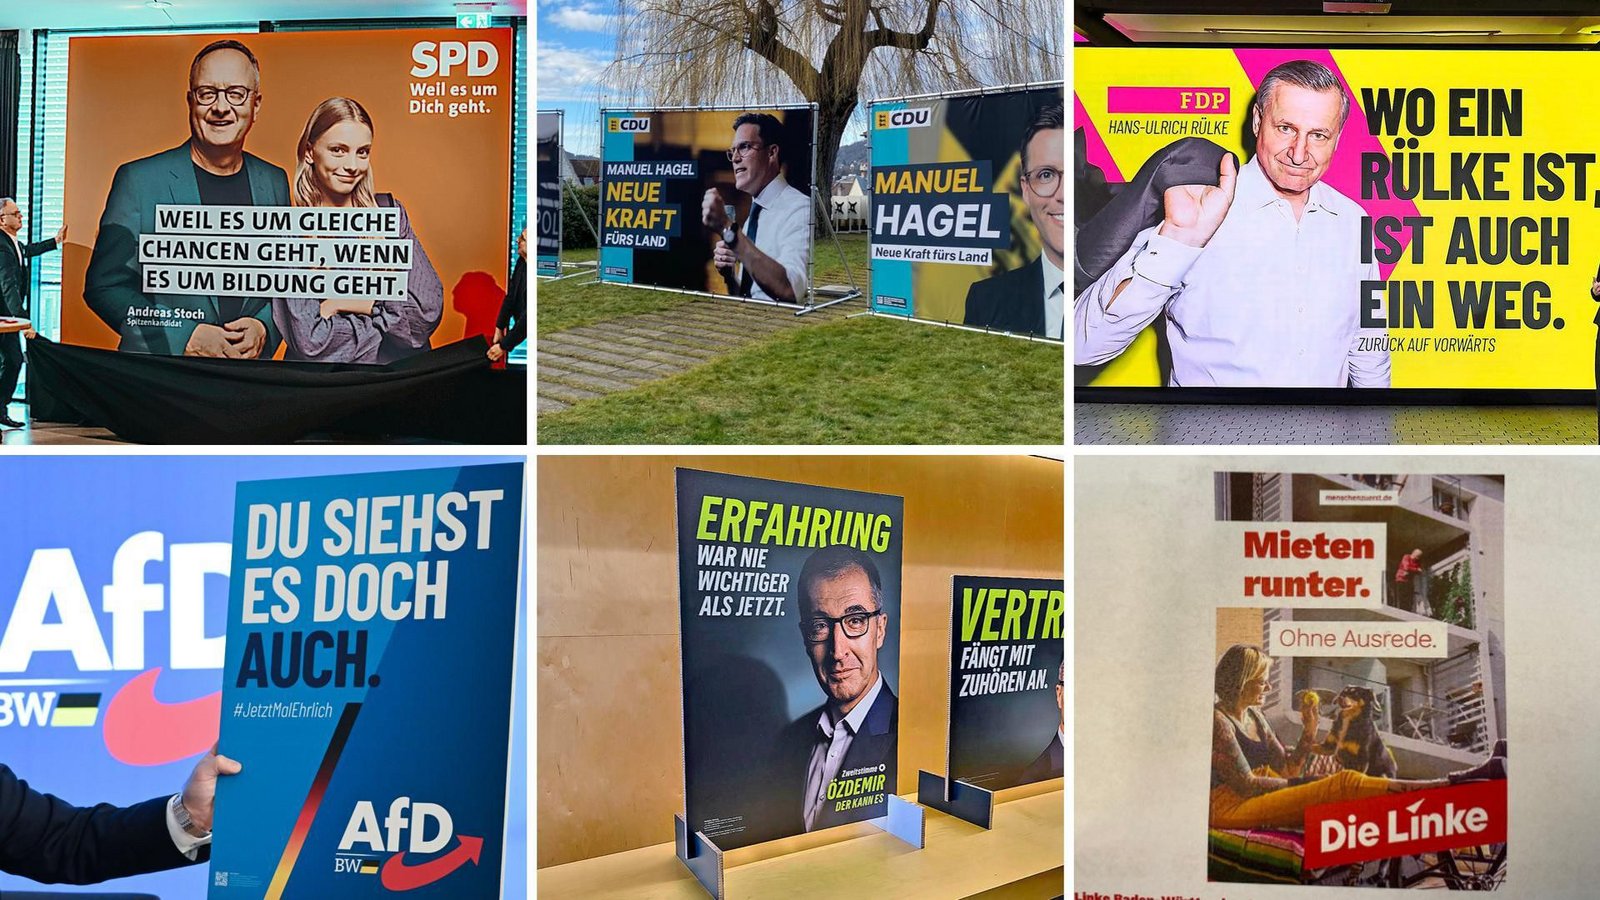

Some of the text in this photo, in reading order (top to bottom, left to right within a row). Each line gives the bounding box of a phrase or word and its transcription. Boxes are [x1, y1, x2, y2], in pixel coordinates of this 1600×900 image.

[410, 41, 499, 78] SPD
[410, 82, 497, 97] Weil es um
[1180, 92, 1225, 109] FDP
[410, 99, 491, 117] Dich geht.
[891, 111, 928, 126] CDU
[1361, 88, 1522, 137] WO EIN
[620, 119, 648, 130] CDU
[1109, 117, 1229, 135] HANS-ULRICH RÜLKE
[607, 164, 694, 176] MANUEL HAGEL
[1361, 136, 1510, 201] RÜLKE
[607, 182, 661, 202] NEUE
[875, 168, 984, 194] MANUEL
[160, 210, 396, 231] WEIL ES UM GLEICHE
[605, 208, 676, 230] KRAFT
[875, 204, 1000, 238] HAGEL
[605, 230, 666, 248] FÜRS LAND
[1361, 216, 1569, 265] IST AUCH
[143, 240, 409, 266] CHANCEN GEHT, WENN
[875, 247, 988, 263] Neue Kraft fürs Land
[147, 270, 404, 296] ES UM BILDUNG GEHT.
[127, 306, 205, 320] Andreas Stoch
[1360, 280, 1565, 330] EIN WEG.
[127, 318, 182, 327] Spitzenkandidat
[1358, 335, 1496, 353] ZURÜCK AUF VORWÄRTS
[246, 489, 504, 561] DU SIEHST
[696, 495, 892, 553] ERFAHRUNG
[697, 544, 768, 568] WAR NIE
[1244, 529, 1375, 560] Mieten
[241, 560, 449, 624] ES DOCH
[697, 570, 789, 593] WICHTIGER
[1244, 571, 1370, 598] runter.
[0, 531, 232, 673] AfD
[699, 596, 785, 616] ALS JETZT.
[961, 587, 1064, 642] VERTR
[1279, 629, 1437, 649] Ohne Ausrede.
[236, 630, 381, 689] AUCH.
[960, 642, 1035, 669] FÄNGT MIT
[959, 668, 1048, 697] ZUHÖREN AN.
[233, 702, 333, 719] #JetztMalEhrlich
[841, 766, 878, 778] Zweitstimme
[827, 774, 886, 800] ÖZDEMIR
[835, 793, 885, 812] DER KANN ES
[337, 797, 454, 853] AfD
[1320, 799, 1488, 853] Die Linke
[334, 858, 362, 873] BW
